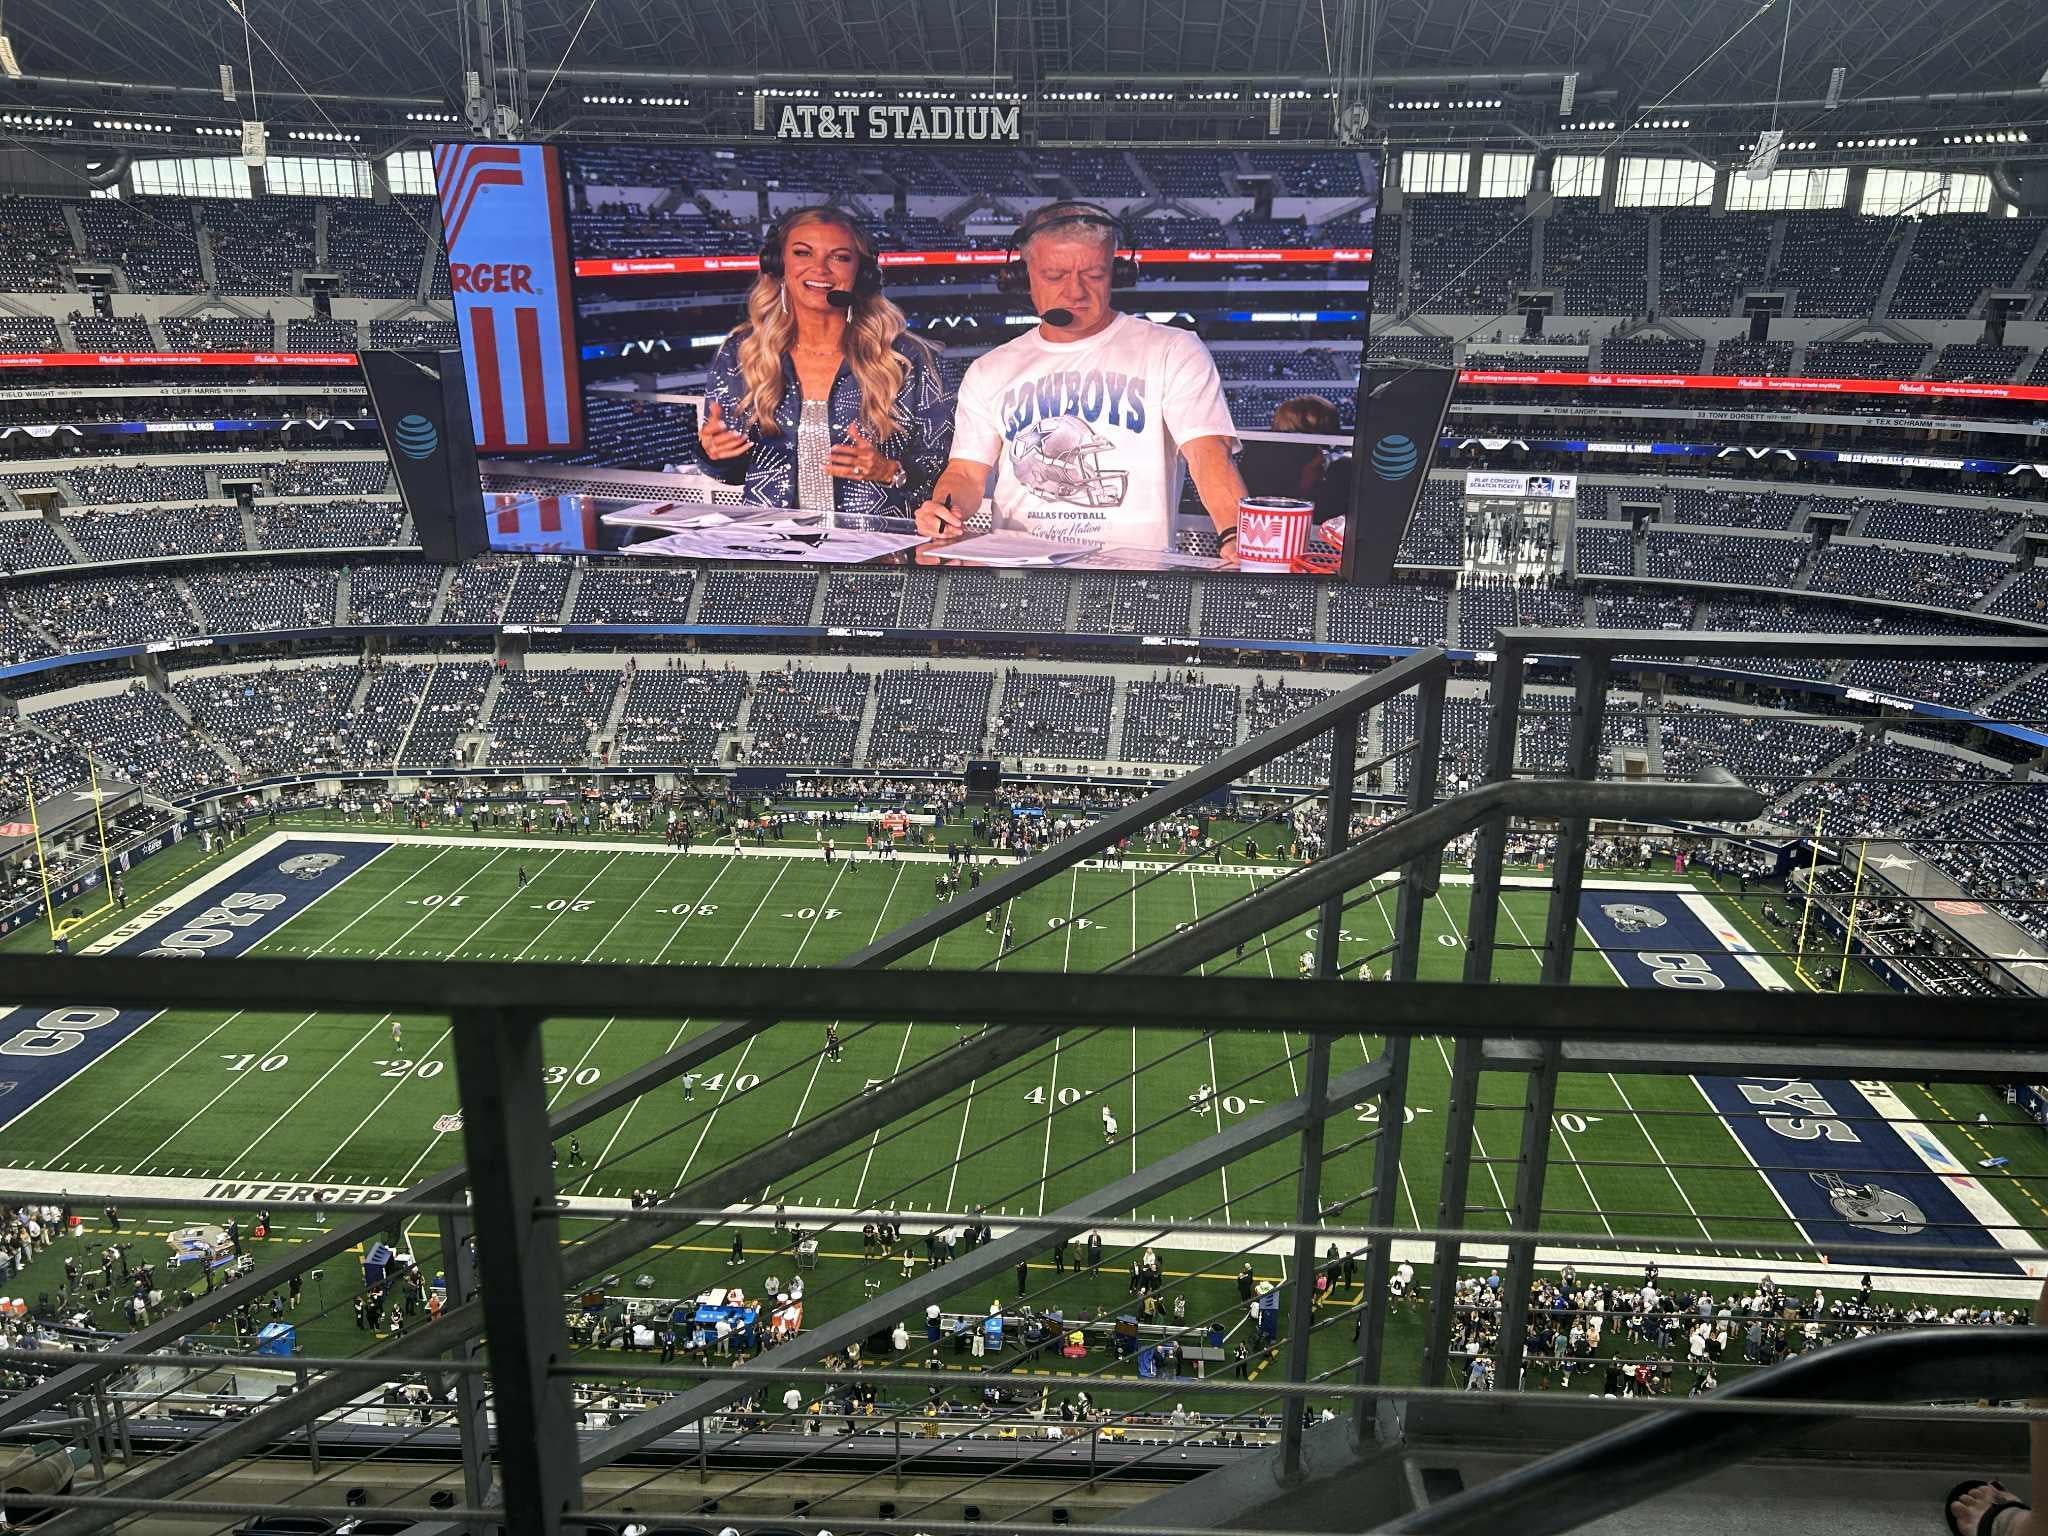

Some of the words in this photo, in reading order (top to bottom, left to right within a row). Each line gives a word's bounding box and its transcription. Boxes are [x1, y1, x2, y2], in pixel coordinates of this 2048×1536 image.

[777, 105, 860, 138] AT&T
[868, 106, 1021, 139] STADIUM
[25, 390, 55, 398] WRIGHT
[1001, 368, 1146, 441] COWBOYS
[1553, 407, 1569, 415] TOM
[1570, 408, 1598, 416] LANDRY
[1697, 411, 1706, 419] 33
[1709, 412, 1728, 420] TONY
[1729, 412, 1765, 421] DORSETT
[1875, 418, 1891, 426] TEX
[1893, 419, 1933, 428] SCHRAMM
[1862, 454, 1903, 466] FOOTBALL
[1027, 511, 1057, 519] DALLAS
[1058, 511, 1107, 520] FOOTBALL
[533, 626, 562, 634] Mortgage
[856, 629, 884, 637] Mortgage
[180, 639, 213, 648] Mortgage
[1171, 638, 1199, 646] Mortgage
[1879, 696, 1914, 710] Mortgage
[113, 923, 143, 937] OF
[226, 1053, 289, 1072] 10
[380, 1059, 444, 1078] 20
[543, 1066, 601, 1085] 30
[700, 1073, 760, 1092] 40
[1023, 1086, 1081, 1106] 40
